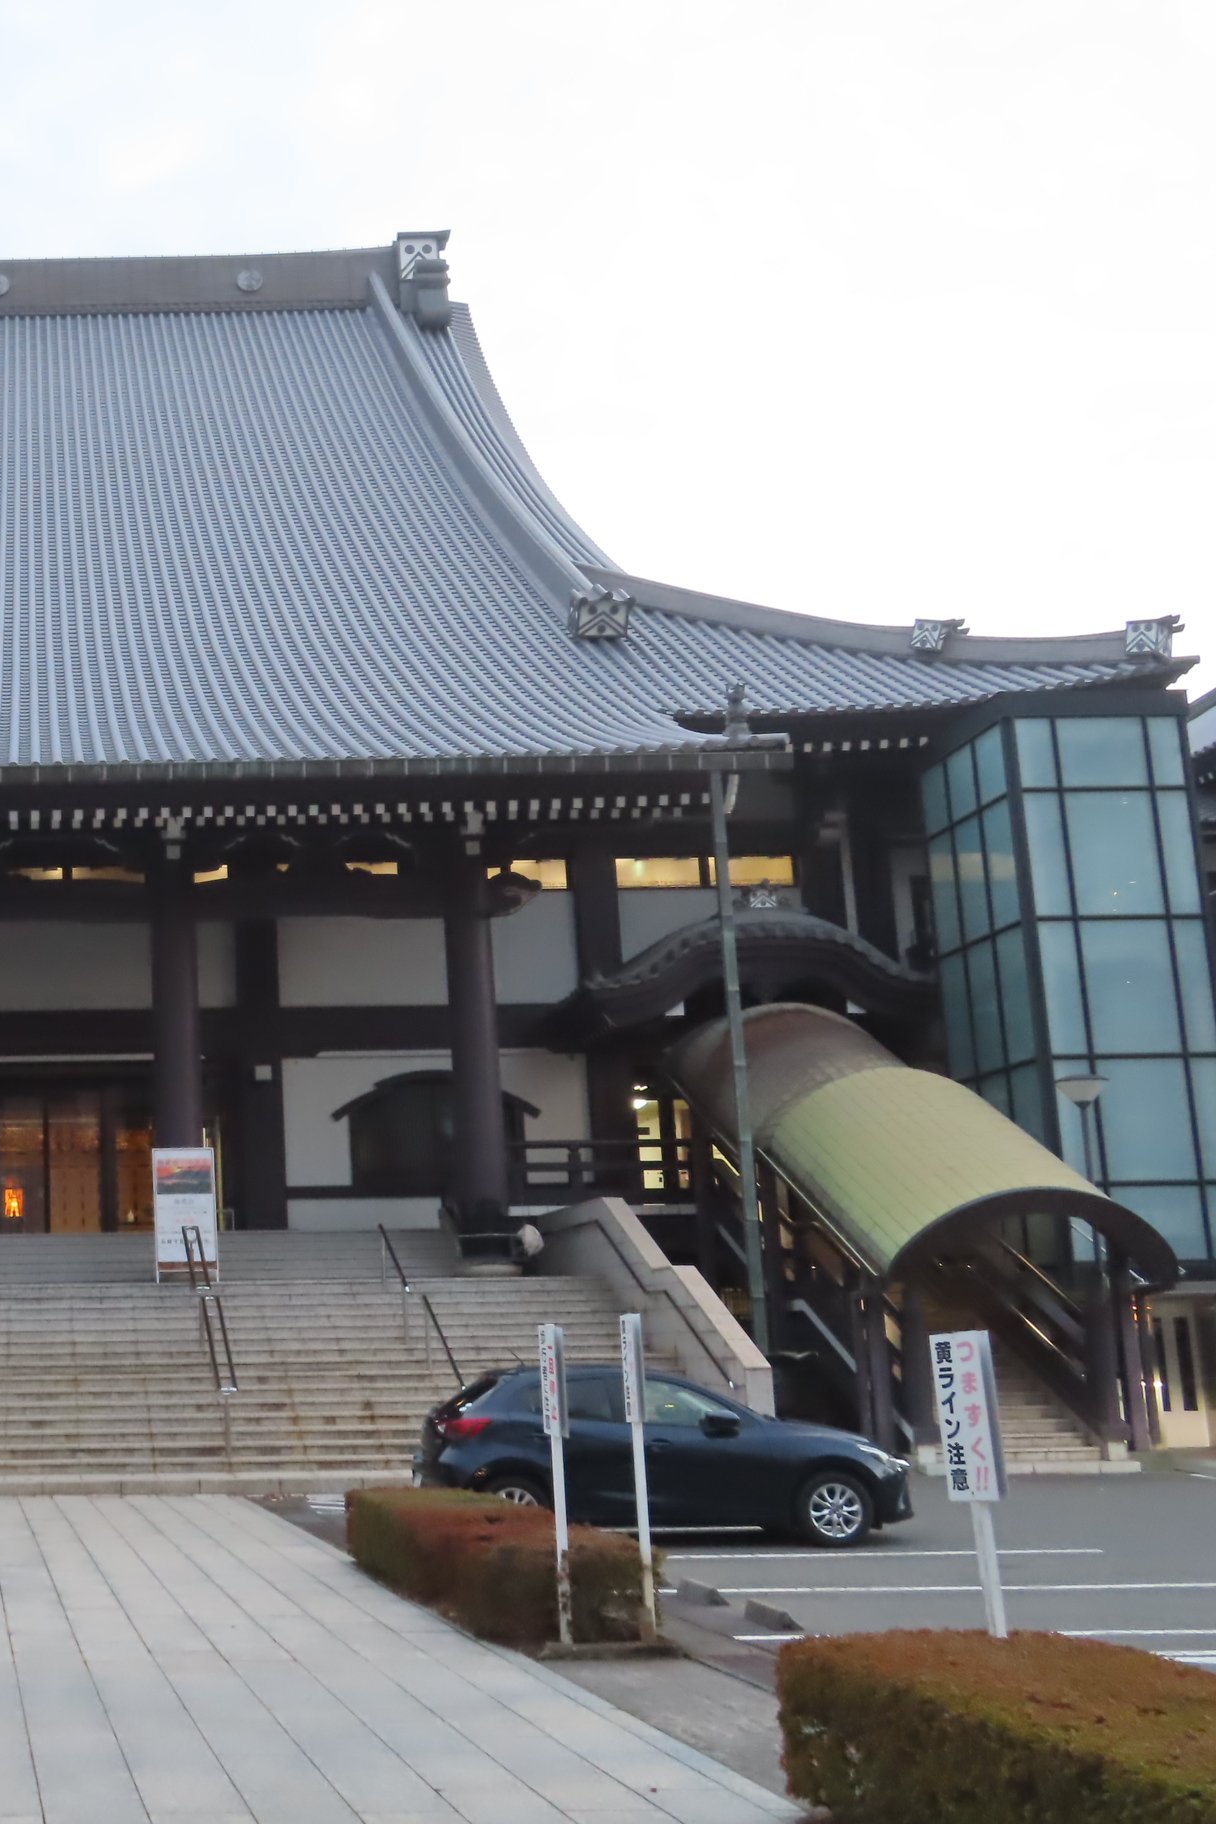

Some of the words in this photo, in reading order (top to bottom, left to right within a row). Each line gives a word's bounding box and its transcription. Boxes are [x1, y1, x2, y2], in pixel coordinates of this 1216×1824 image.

[935, 1341, 970, 1491] 黄ライン注意
